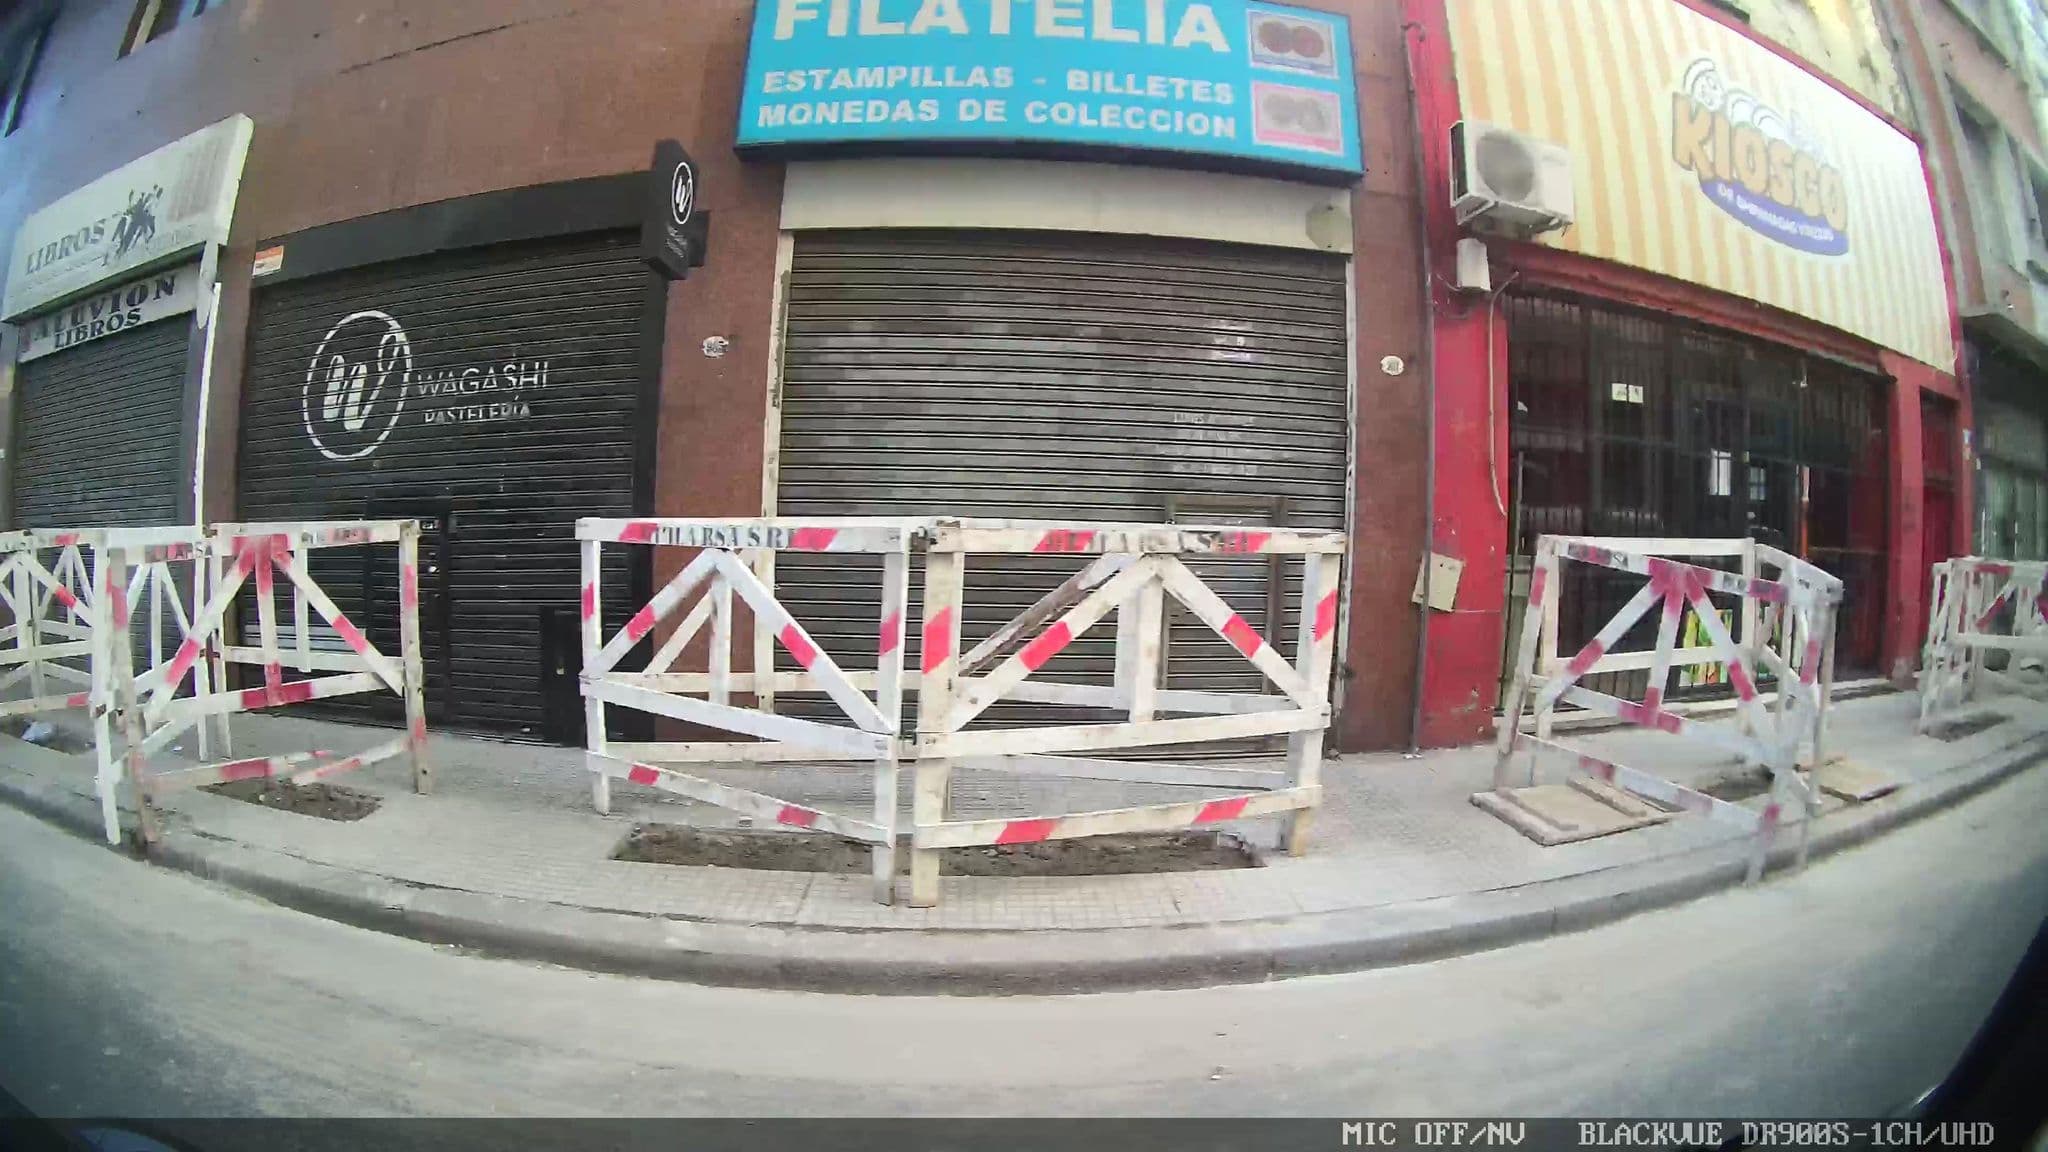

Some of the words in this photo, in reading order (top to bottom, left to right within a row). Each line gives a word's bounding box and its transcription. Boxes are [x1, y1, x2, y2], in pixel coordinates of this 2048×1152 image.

[773, 0, 1231, 52] FILATELIA
[764, 66, 1014, 93] ESTAMPILLAS
[1067, 70, 1234, 104] BILLETES
[758, 98, 940, 127] MONEDAS
[958, 99, 1007, 121] DE
[1024, 102, 1236, 138] COLECCION
[1672, 91, 1848, 232] KIOSCO
[26, 218, 106, 275] LIBROS
[54, 307, 142, 348] LIBROS
[418, 361, 548, 396] WAGASHI
